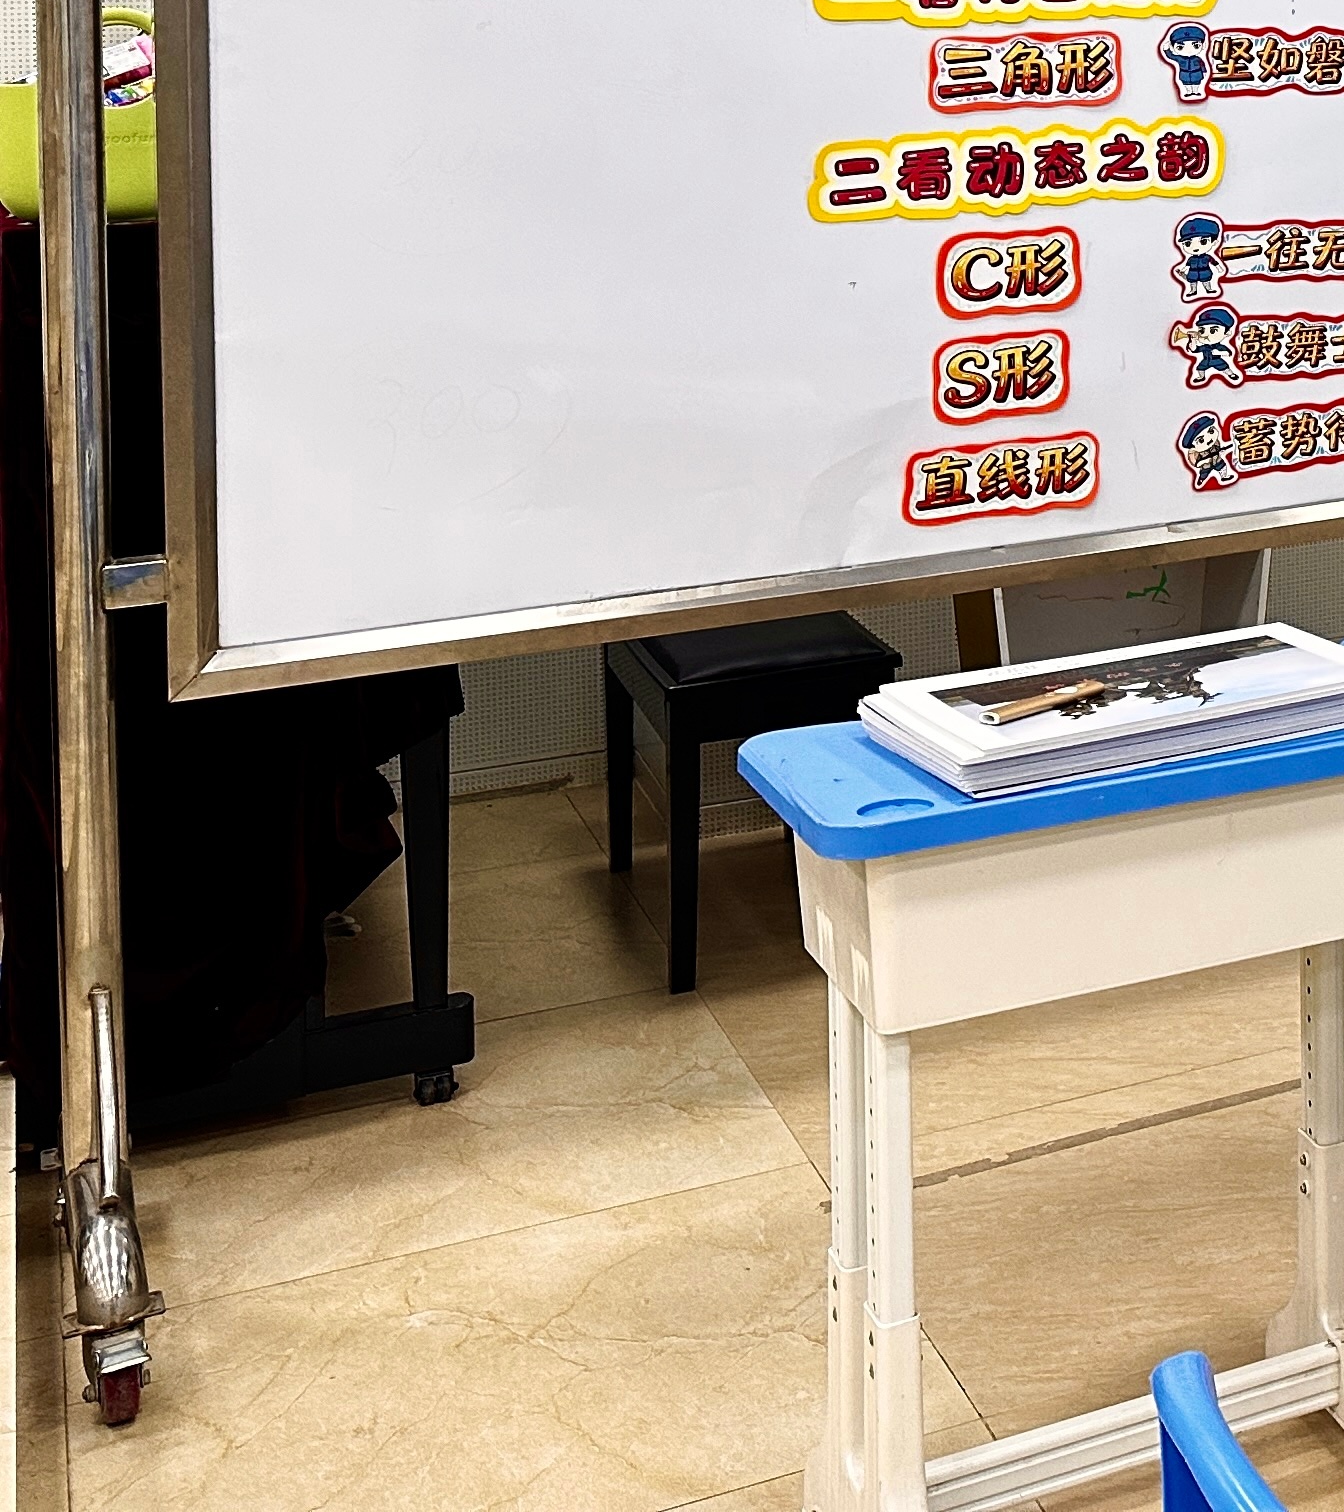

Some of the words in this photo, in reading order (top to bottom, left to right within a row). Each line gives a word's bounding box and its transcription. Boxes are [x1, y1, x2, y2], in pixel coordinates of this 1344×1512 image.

[936, 40, 1114, 99] 三角形
[830, 132, 1209, 205] 二看动态之韵
[950, 240, 1069, 303] C形
[945, 342, 1057, 409] S形
[917, 442, 1093, 511] 直线形
